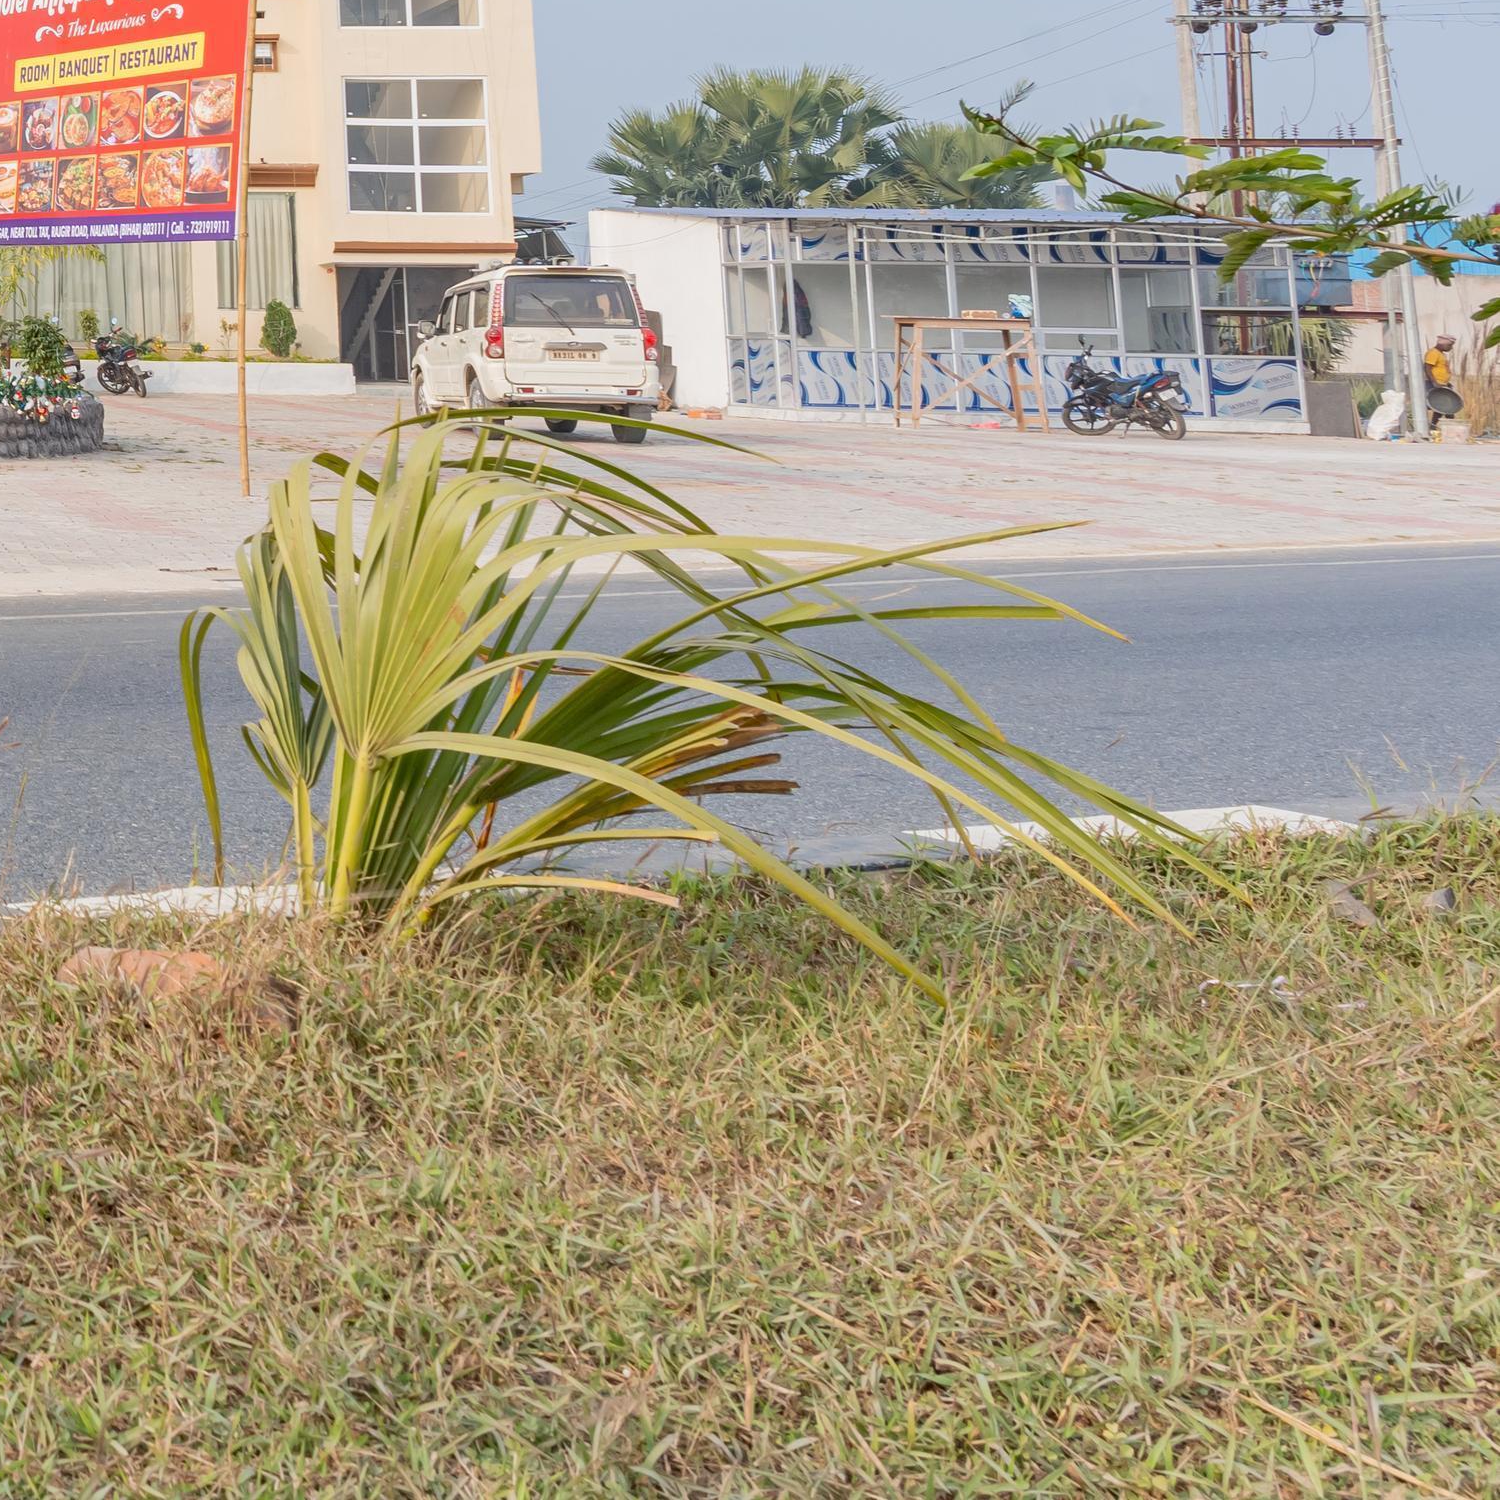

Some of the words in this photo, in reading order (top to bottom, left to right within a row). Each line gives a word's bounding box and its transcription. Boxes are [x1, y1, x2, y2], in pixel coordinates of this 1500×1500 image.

[67, 18, 87, 38] The
[88, 13, 146, 37] Luxurious
[19, 63, 50, 84] ROOM
[58, 54, 110, 79] BANQUET
[119, 41, 198, 71] RESTAURANT
[10, 227, 25, 239] NEAR
[25, 226, 38, 238] TOLL
[39, 226, 50, 240] TAX,
[71, 225, 89, 240] ROAD,
[89, 224, 119, 237] NALANDA
[142, 222, 165, 235] 803111
[190, 220, 230, 234] 7321919111
